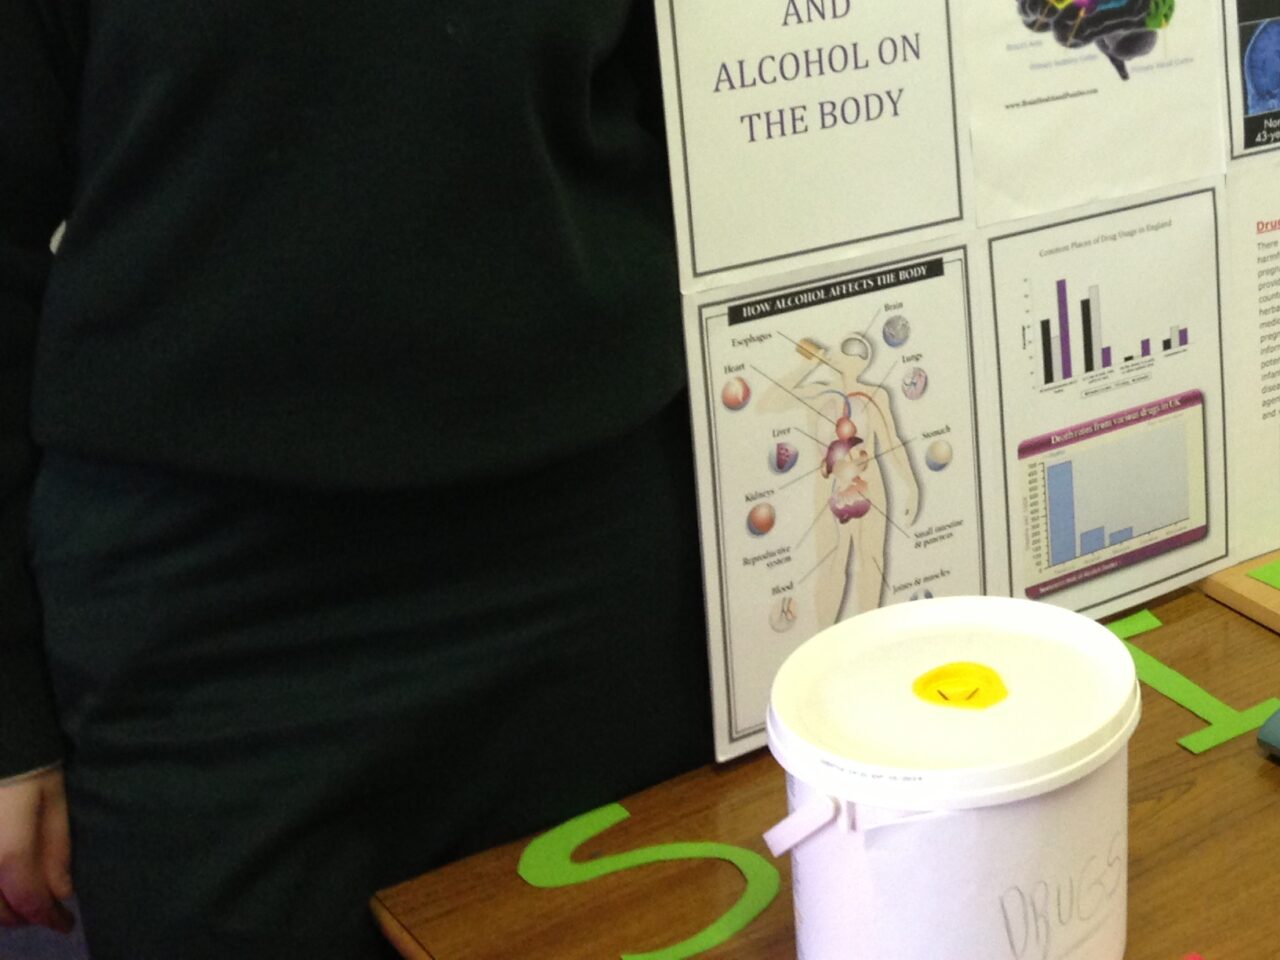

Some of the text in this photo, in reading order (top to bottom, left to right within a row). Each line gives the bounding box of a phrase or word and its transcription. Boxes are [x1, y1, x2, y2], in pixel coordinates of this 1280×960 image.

[713, 32, 922, 93] ALCOHOL ON
[740, 88, 905, 143] THE BODY
[1257, 240, 1278, 250] There
[742, 265, 928, 318] HOW ALCOHOL AFFECTS THE BODY
[884, 301, 903, 313] Brain
[724, 363, 745, 374] Heart
[1262, 409, 1276, 420] and
[772, 427, 791, 438] Liver
[1000, 831, 1122, 960] DRUGS
